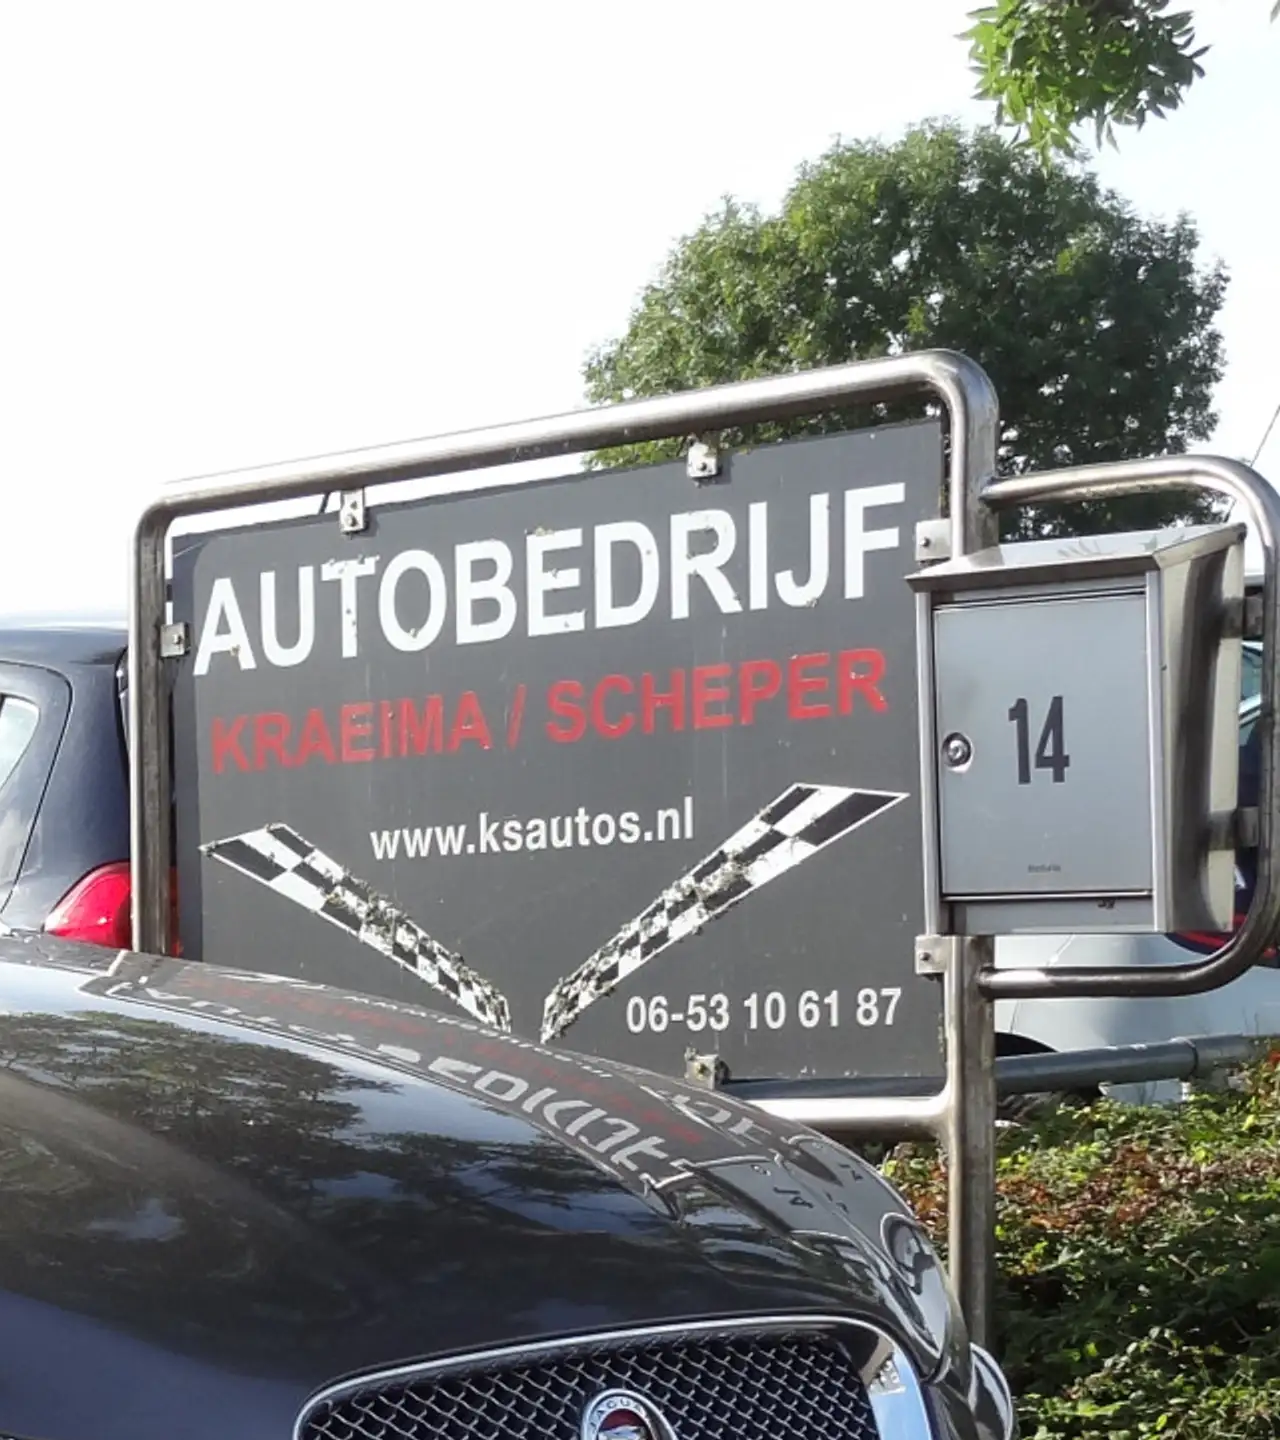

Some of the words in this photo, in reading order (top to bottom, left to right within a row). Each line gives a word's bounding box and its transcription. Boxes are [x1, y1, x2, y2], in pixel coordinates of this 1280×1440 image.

[192, 483, 906, 676] AUTOBEDRIJF
[210, 689, 492, 775] KRAEIMA
[507, 686, 528, 747] /
[545, 648, 889, 744] SCHEPER
[1008, 696, 1070, 784] 14
[370, 796, 694, 860] www.ksautos.nl
[625, 994, 731, 1034] 06-53
[744, 992, 788, 1029] 10
[798, 990, 841, 1028] 61
[855, 986, 903, 1026] 87
